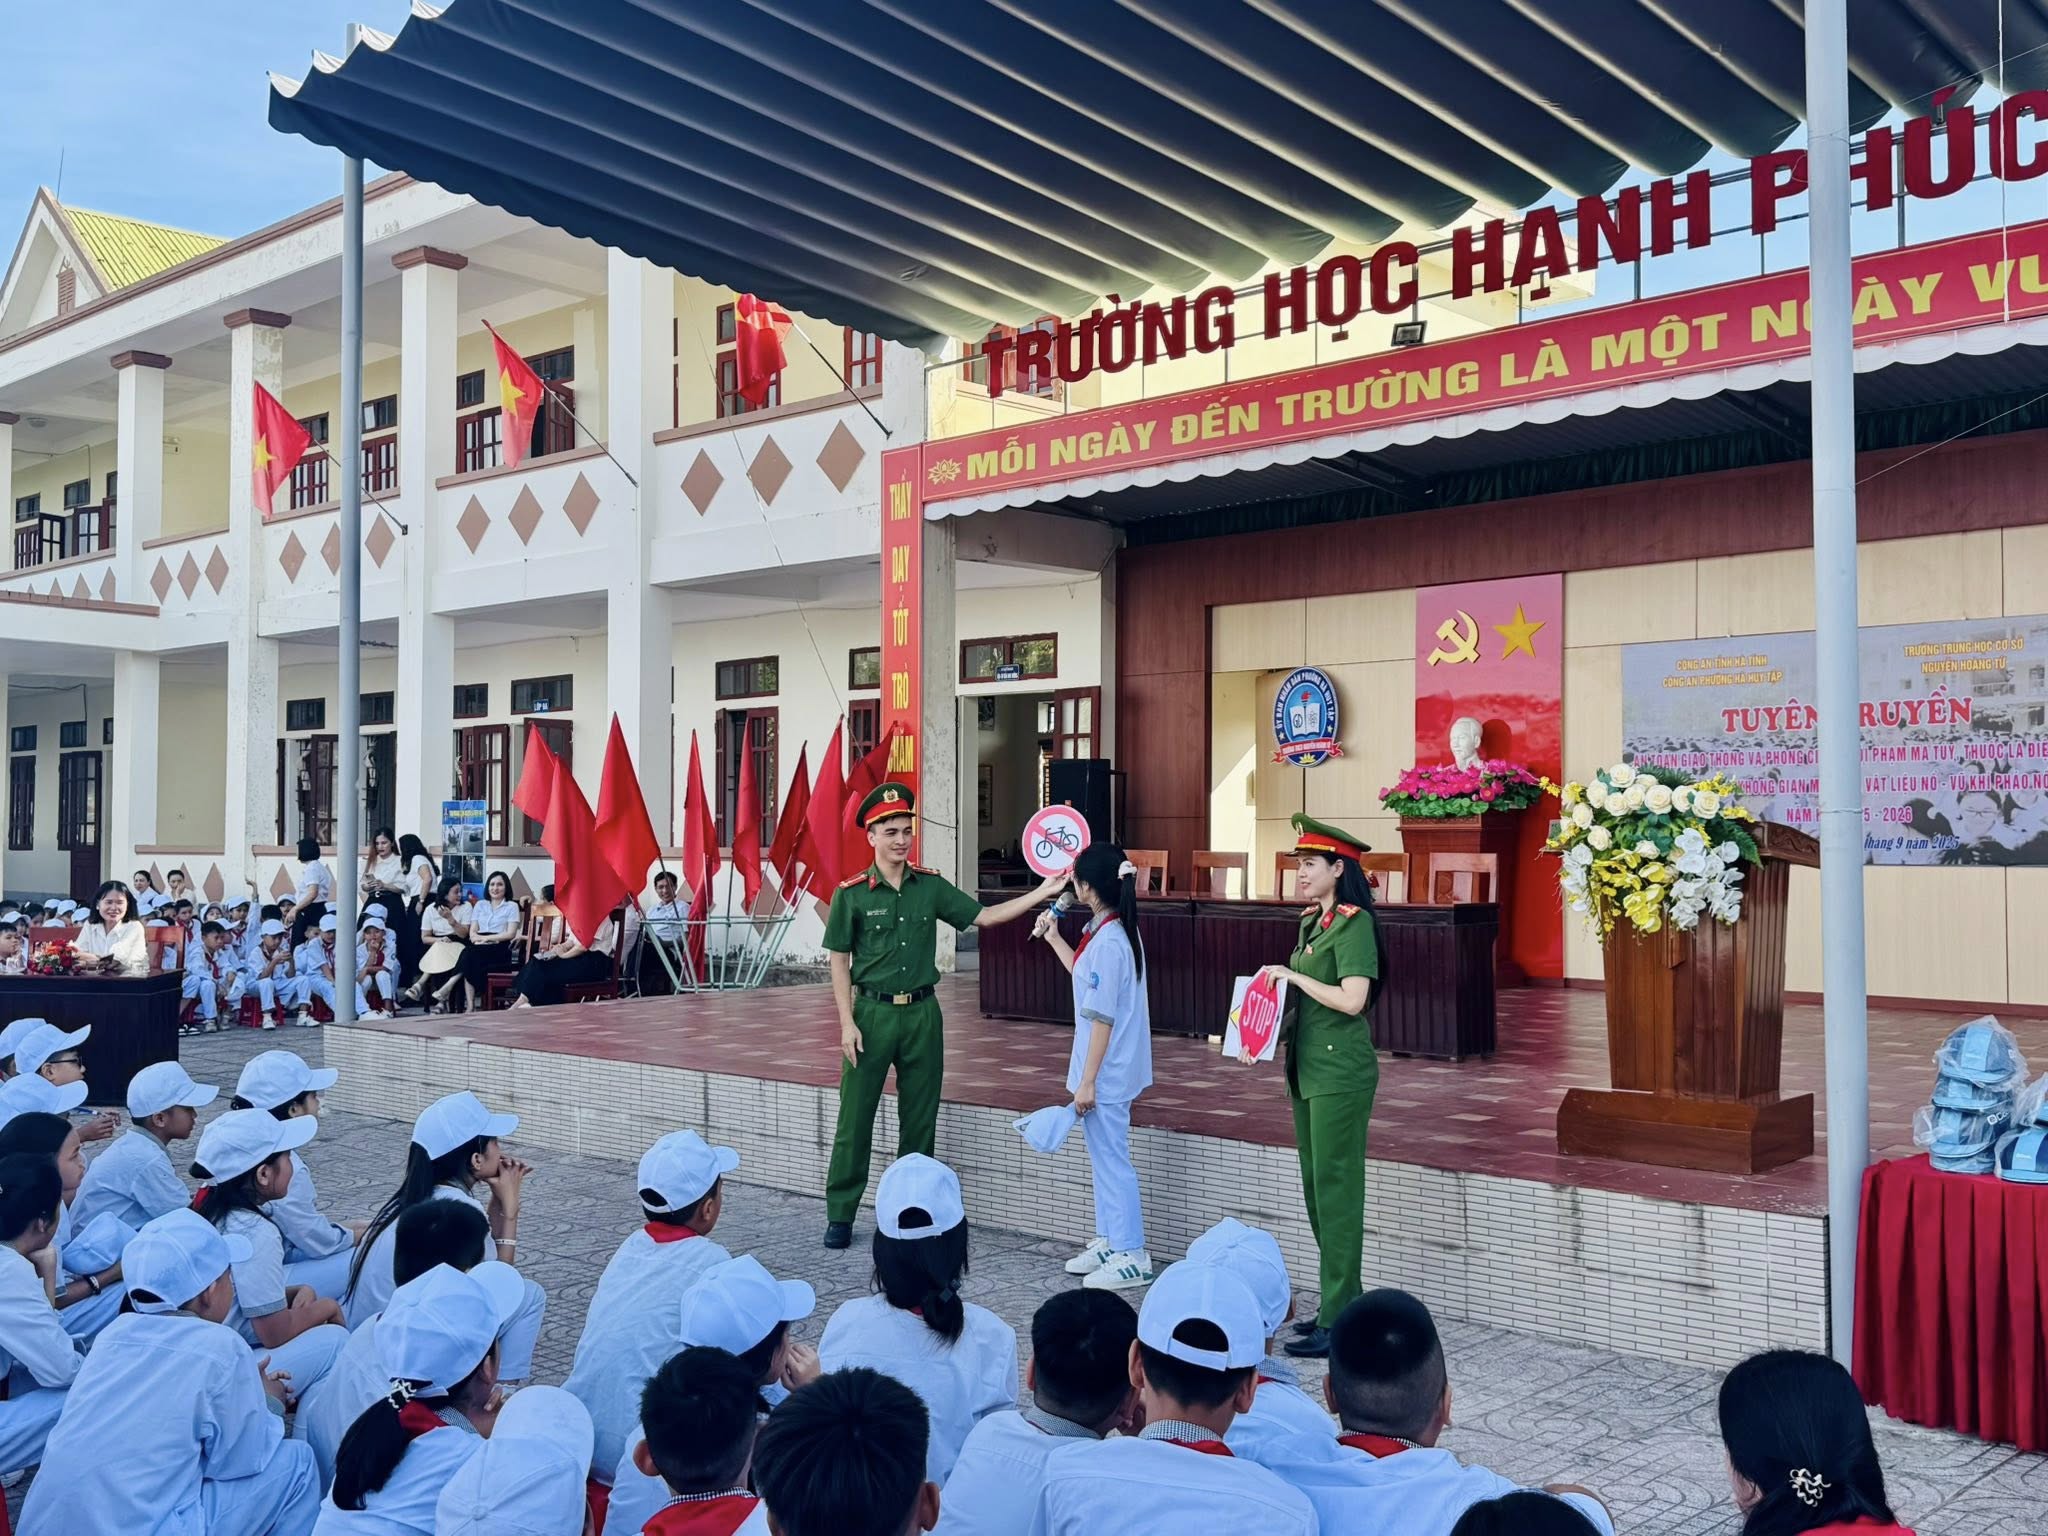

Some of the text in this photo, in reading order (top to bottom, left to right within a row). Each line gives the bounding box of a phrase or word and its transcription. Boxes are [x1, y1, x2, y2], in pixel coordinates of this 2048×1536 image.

[981, 86, 2048, 399] TRƯỜNG HỌC HẠNH PHÚC
[967, 434, 1035, 481] MỖI
[1050, 421, 1158, 467] NGÀY
[1171, 396, 1260, 445] ĐẾN
[1276, 360, 1479, 426] TRƯỜNG
[1500, 338, 1570, 387] LÀ
[1591, 312, 1728, 371] MỘT
[1751, 272, 1943, 343] NÀY
[1942, 641, 1972, 654] TRUNG
[1974, 640, 1993, 654] HỌC
[1676, 657, 1698, 671] CÔNG
[1701, 658, 1712, 670] AN
[891, 662, 909, 710] TRÒ
[1663, 675, 1685, 688] CÔNG
[1686, 676, 1697, 688] AN
[1748, 672, 1764, 684] HUY
[1721, 684, 1973, 732] TUYÊN RUYỀN
[1681, 752, 1706, 767] GIAO
[1872, 746, 1906, 765] PHẠM
[1911, 745, 1929, 761] MA
[1964, 739, 2004, 760] THUỐC
[1779, 779, 1806, 794] GIAN
[1865, 774, 1886, 795] VẬT
[1891, 773, 1917, 795] LIỆU
[1786, 805, 1811, 822] NĂM
[1883, 807, 1912, 822] 2026
[1896, 836, 1904, 849] 9
[1932, 836, 1960, 849] 2025
[1243, 990, 1275, 1037] STOP
